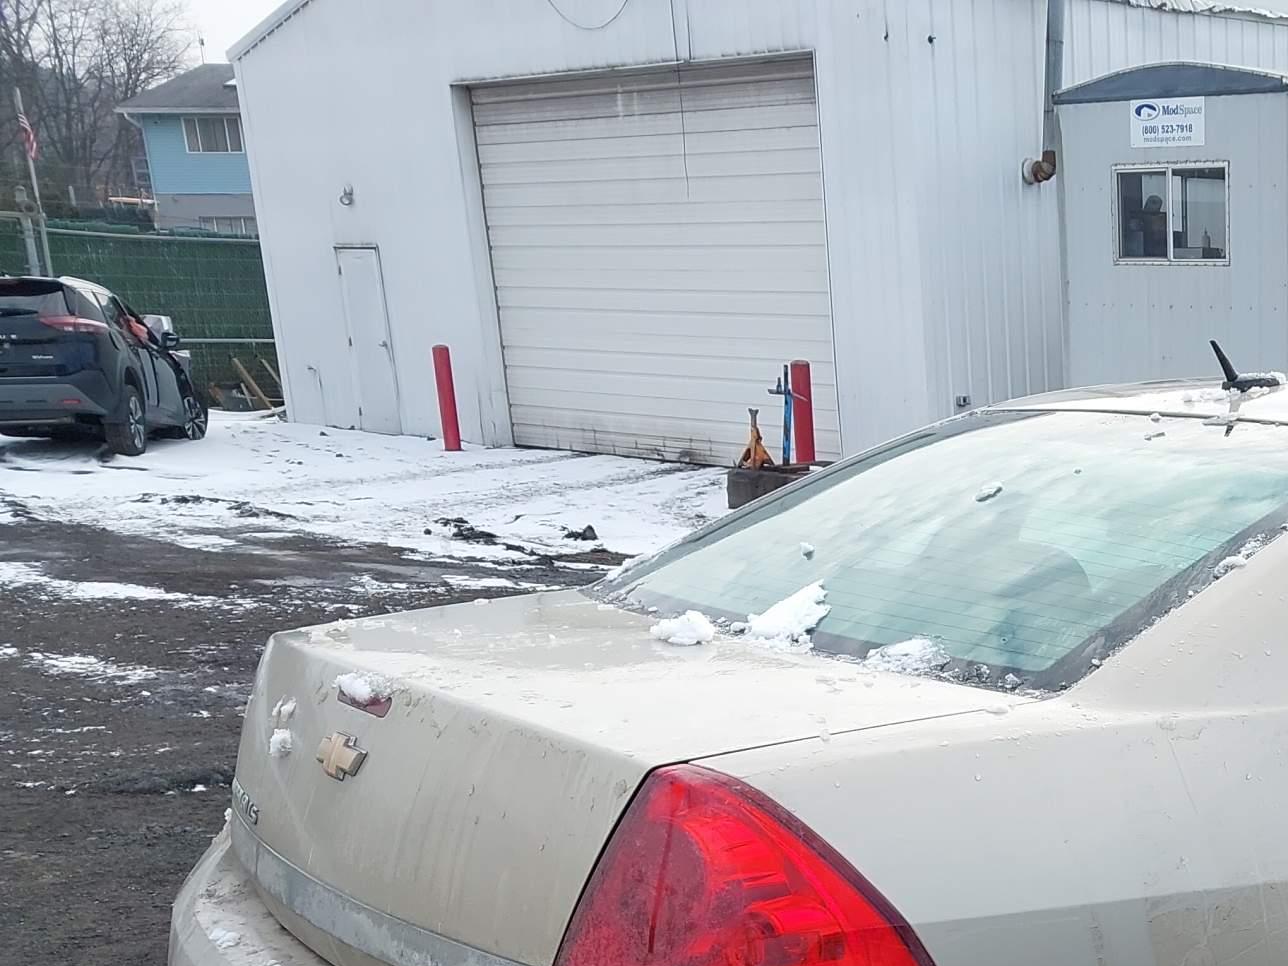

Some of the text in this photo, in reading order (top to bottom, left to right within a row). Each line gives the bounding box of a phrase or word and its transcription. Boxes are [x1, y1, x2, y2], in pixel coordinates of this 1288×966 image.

[1161, 104, 1203, 117] ModSpace
[1141, 123, 1193, 136] (800) 523-7918
[1143, 135, 1192, 144] modspace.com
